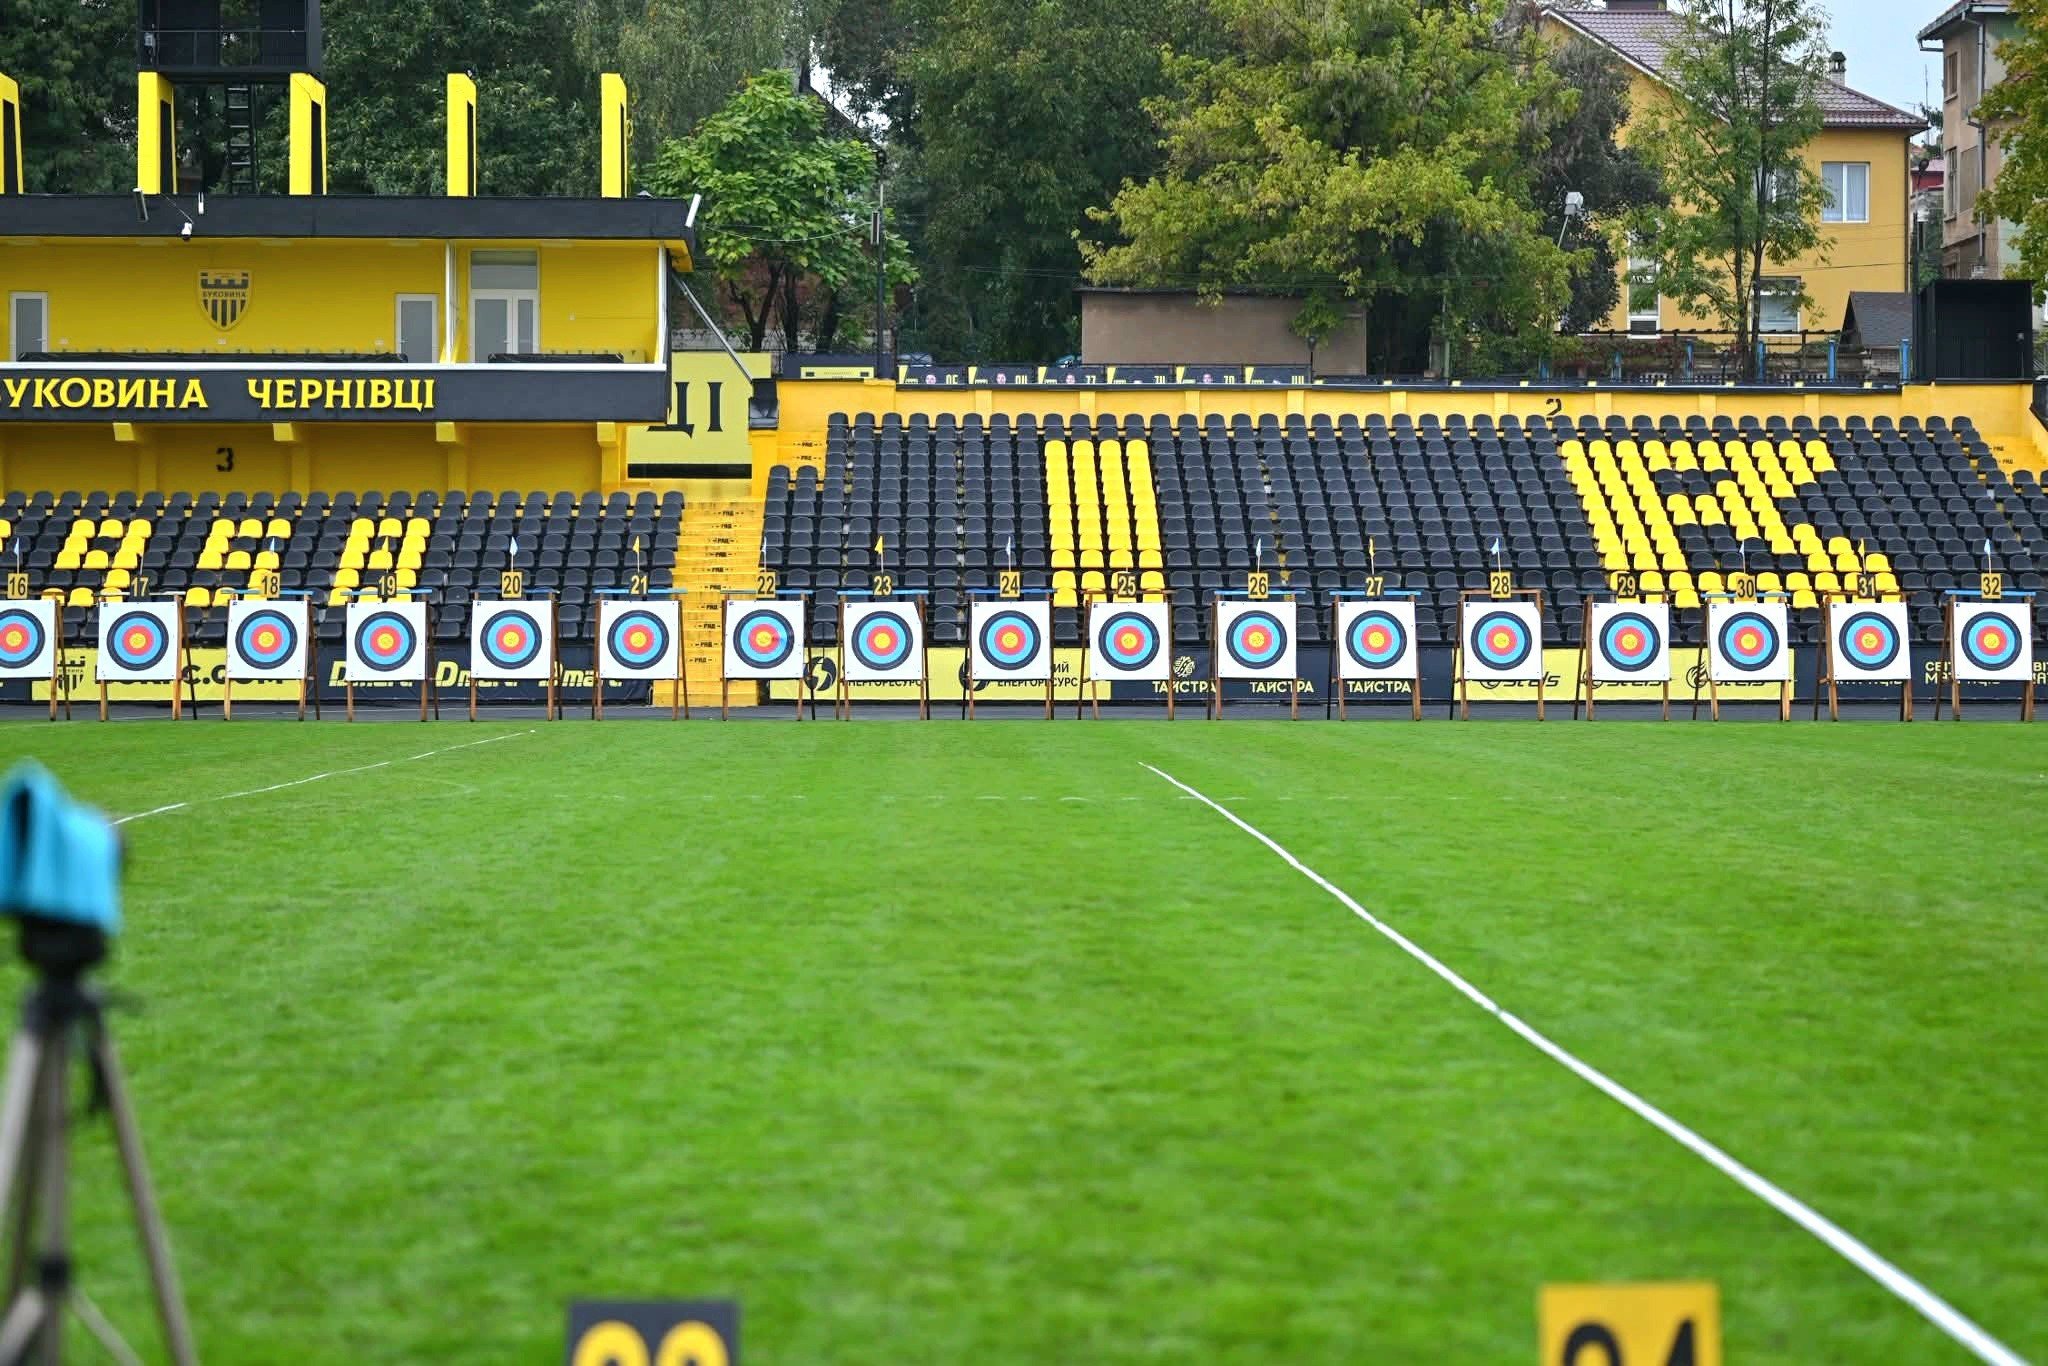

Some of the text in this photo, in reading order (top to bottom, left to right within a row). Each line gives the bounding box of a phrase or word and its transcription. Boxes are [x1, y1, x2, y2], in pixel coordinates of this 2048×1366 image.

[0, 377, 435, 412] УКОВИНА ЧЕРНІВЦІ
[216, 447, 234, 472] 3
[9, 576, 26, 596] 16
[131, 576, 149, 597] 17
[261, 575, 279, 595] 18
[378, 575, 396, 596] 19
[503, 575, 521, 595] 20
[631, 575, 648, 595] 21
[757, 575, 774, 595] 22
[873, 575, 892, 596] 23
[1001, 575, 1019, 595] 24
[1118, 575, 1136, 595] 25
[1250, 576, 1267, 595] 26
[1365, 576, 1384, 597] 27
[1492, 575, 1509, 595] 28
[1617, 575, 1636, 596] 29
[1737, 579, 1754, 598] 30
[1858, 576, 1876, 596] 31
[1983, 576, 2000, 595] 32
[997, 677, 1078, 687] ЕНЕРГОРСУРС
[1346, 680, 1412, 693] ТАЙСТРА
